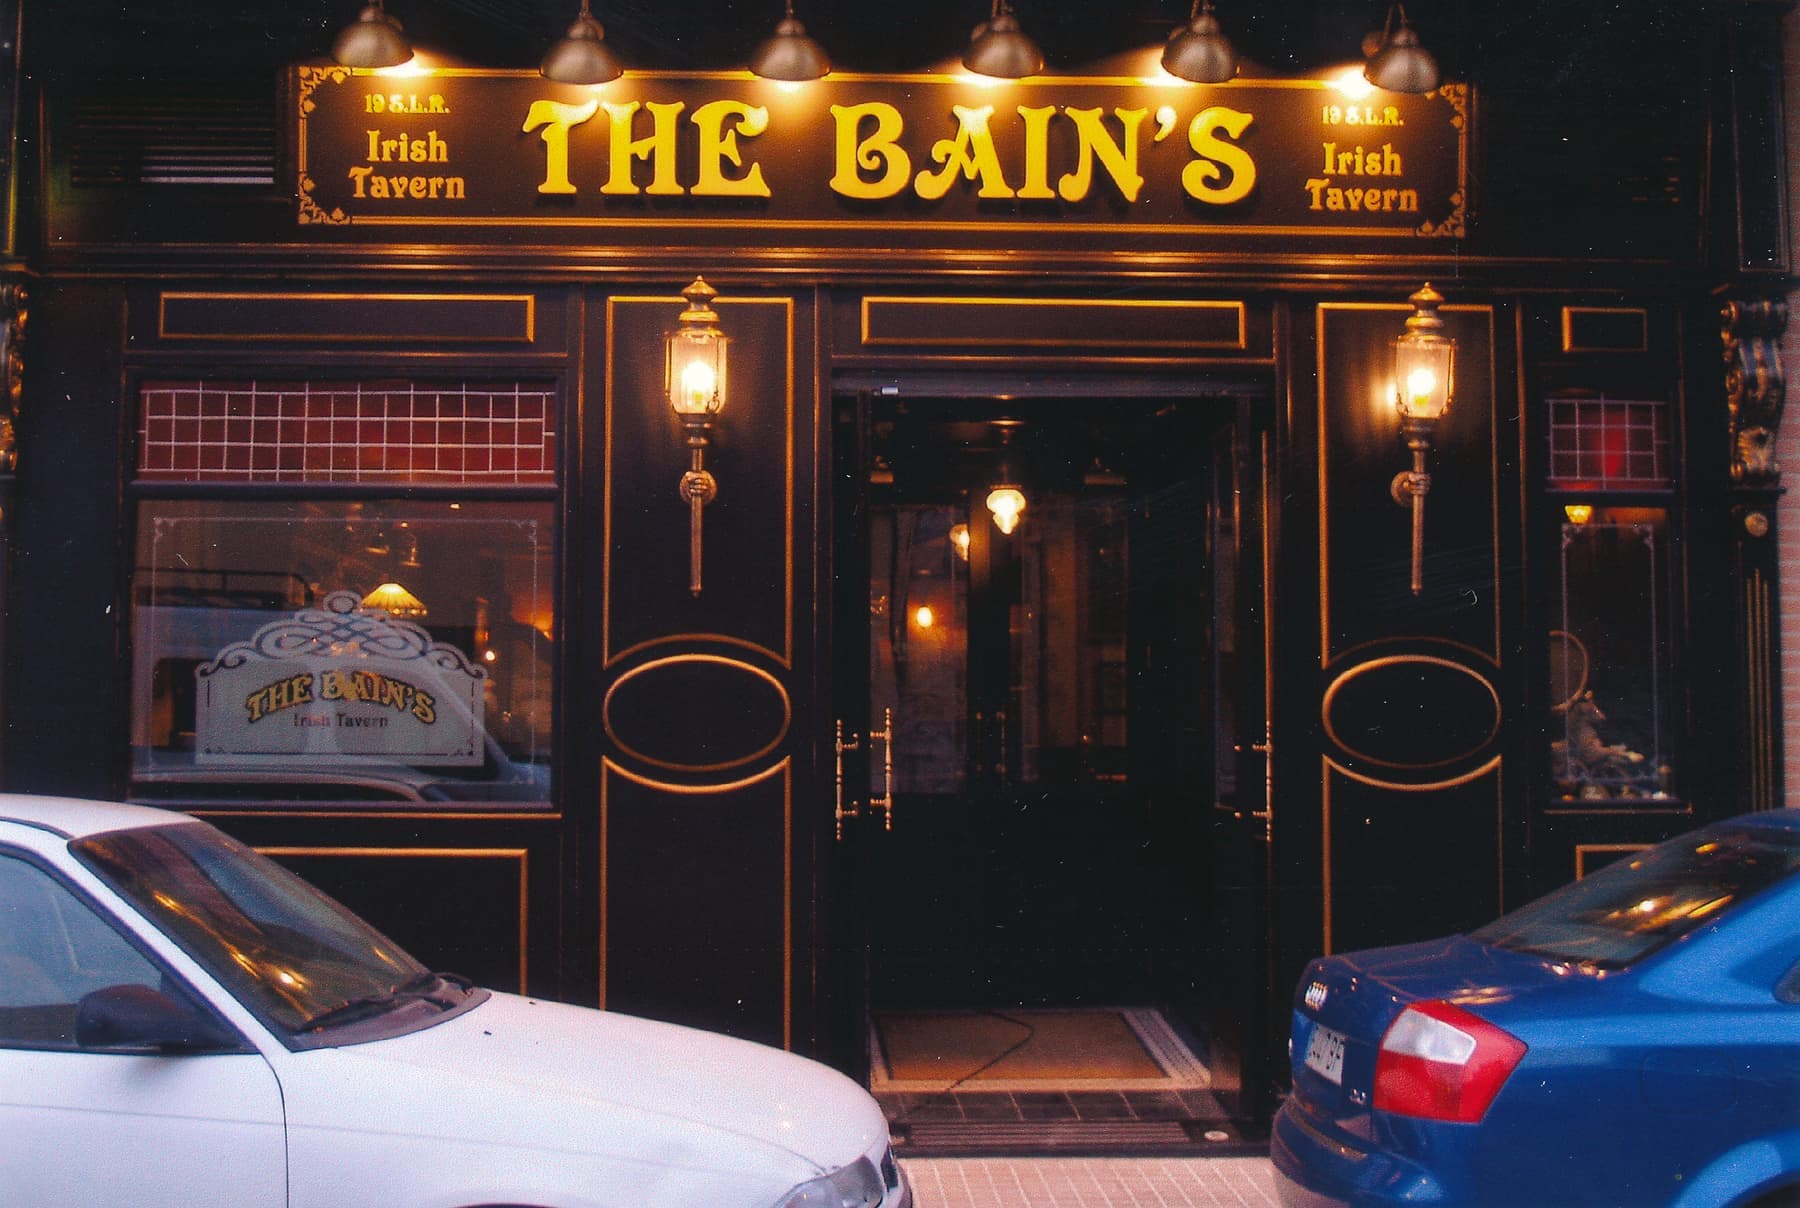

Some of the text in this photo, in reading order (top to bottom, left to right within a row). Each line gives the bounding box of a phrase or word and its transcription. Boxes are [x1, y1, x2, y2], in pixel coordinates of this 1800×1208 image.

[365, 94, 385, 113] 19
[1322, 105, 1341, 125] 19
[366, 129, 449, 162] Irish
[521, 99, 1257, 205] THE BAIN'S
[1322, 142, 1403, 176] Irish
[348, 165, 466, 199] Tavern
[1304, 178, 1419, 212] Tavern
[245, 668, 436, 724] THE BAIN'S
[293, 711, 389, 728] Irish Tavern
